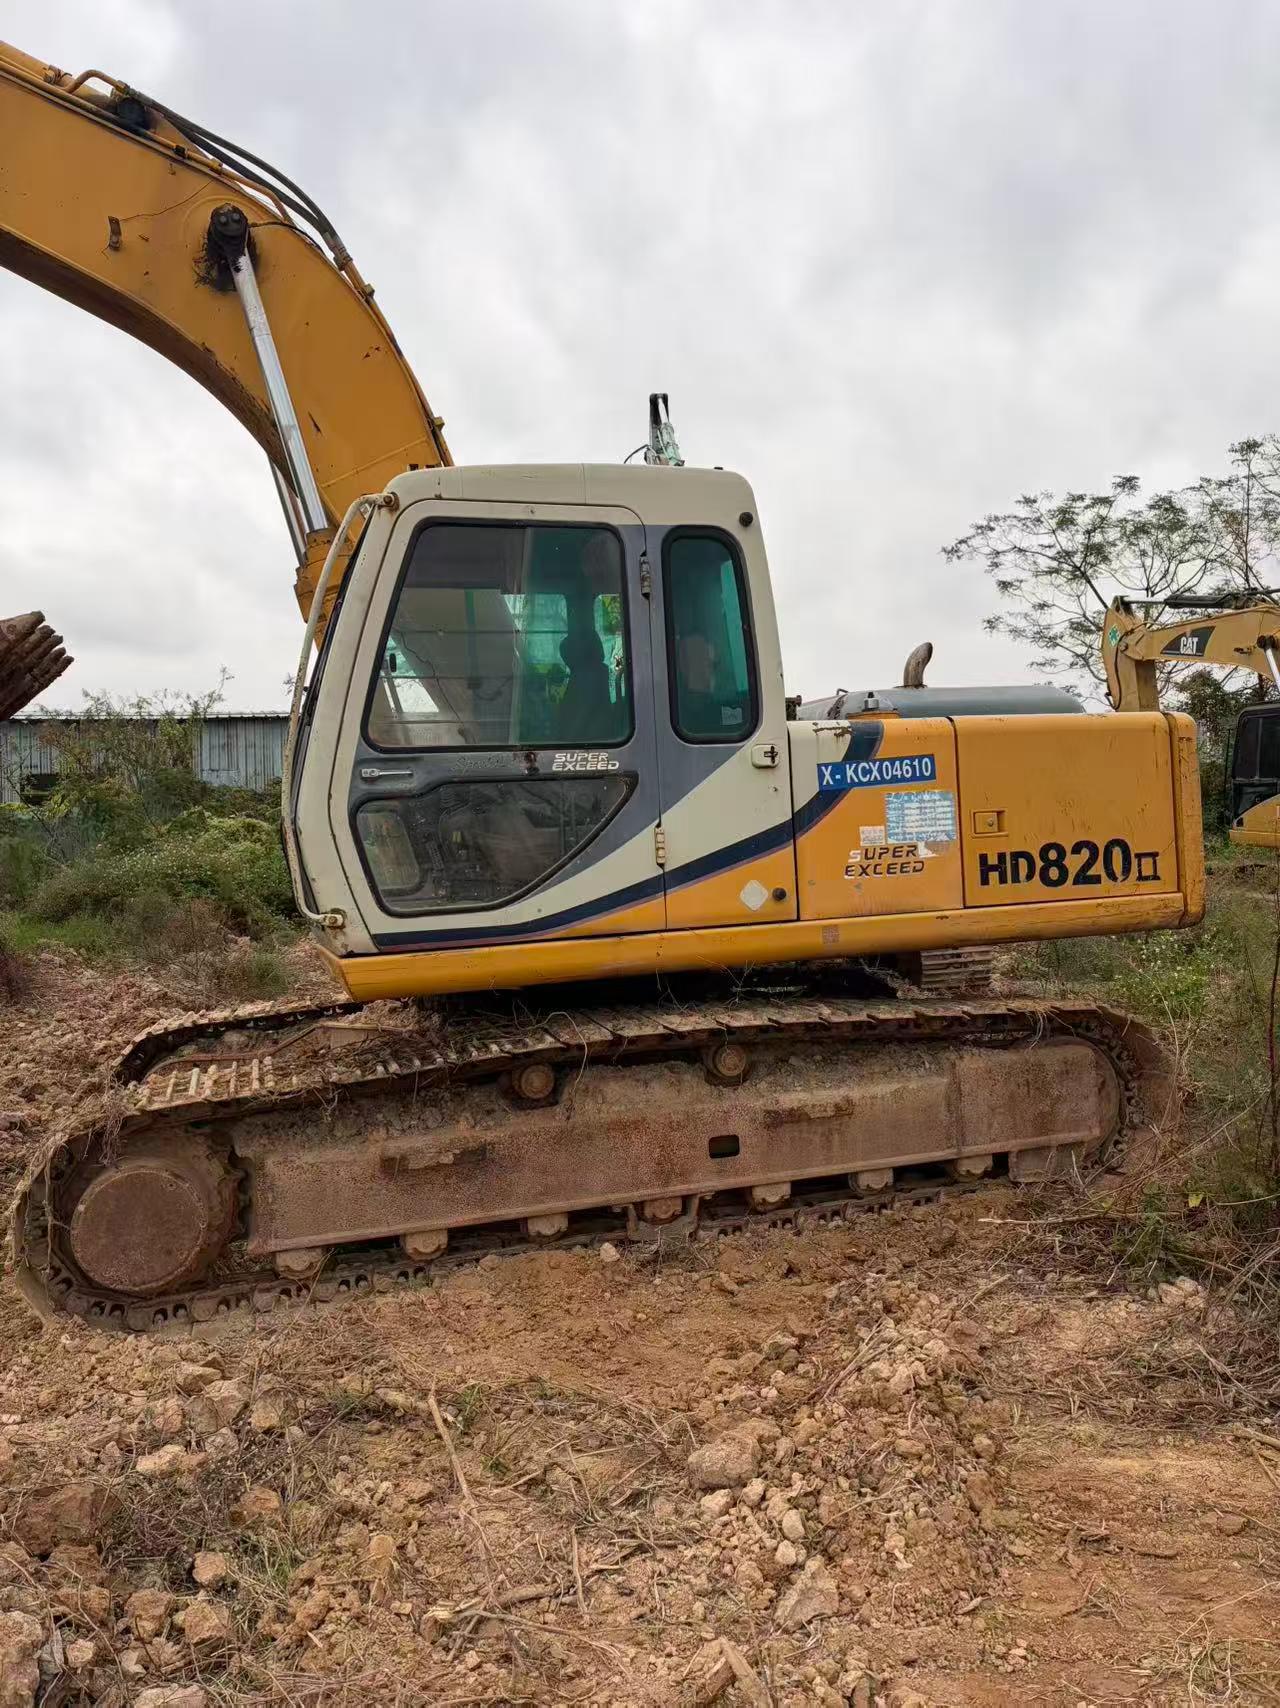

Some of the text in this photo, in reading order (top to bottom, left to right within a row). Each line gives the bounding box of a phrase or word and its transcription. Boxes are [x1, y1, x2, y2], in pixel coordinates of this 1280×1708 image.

[1180, 636, 1199, 655] CAT
[552, 760, 620, 772] EXCEED
[553, 752, 609, 763] SUPER
[848, 844, 918, 863] SUPER
[844, 860, 926, 879] EXCEED
